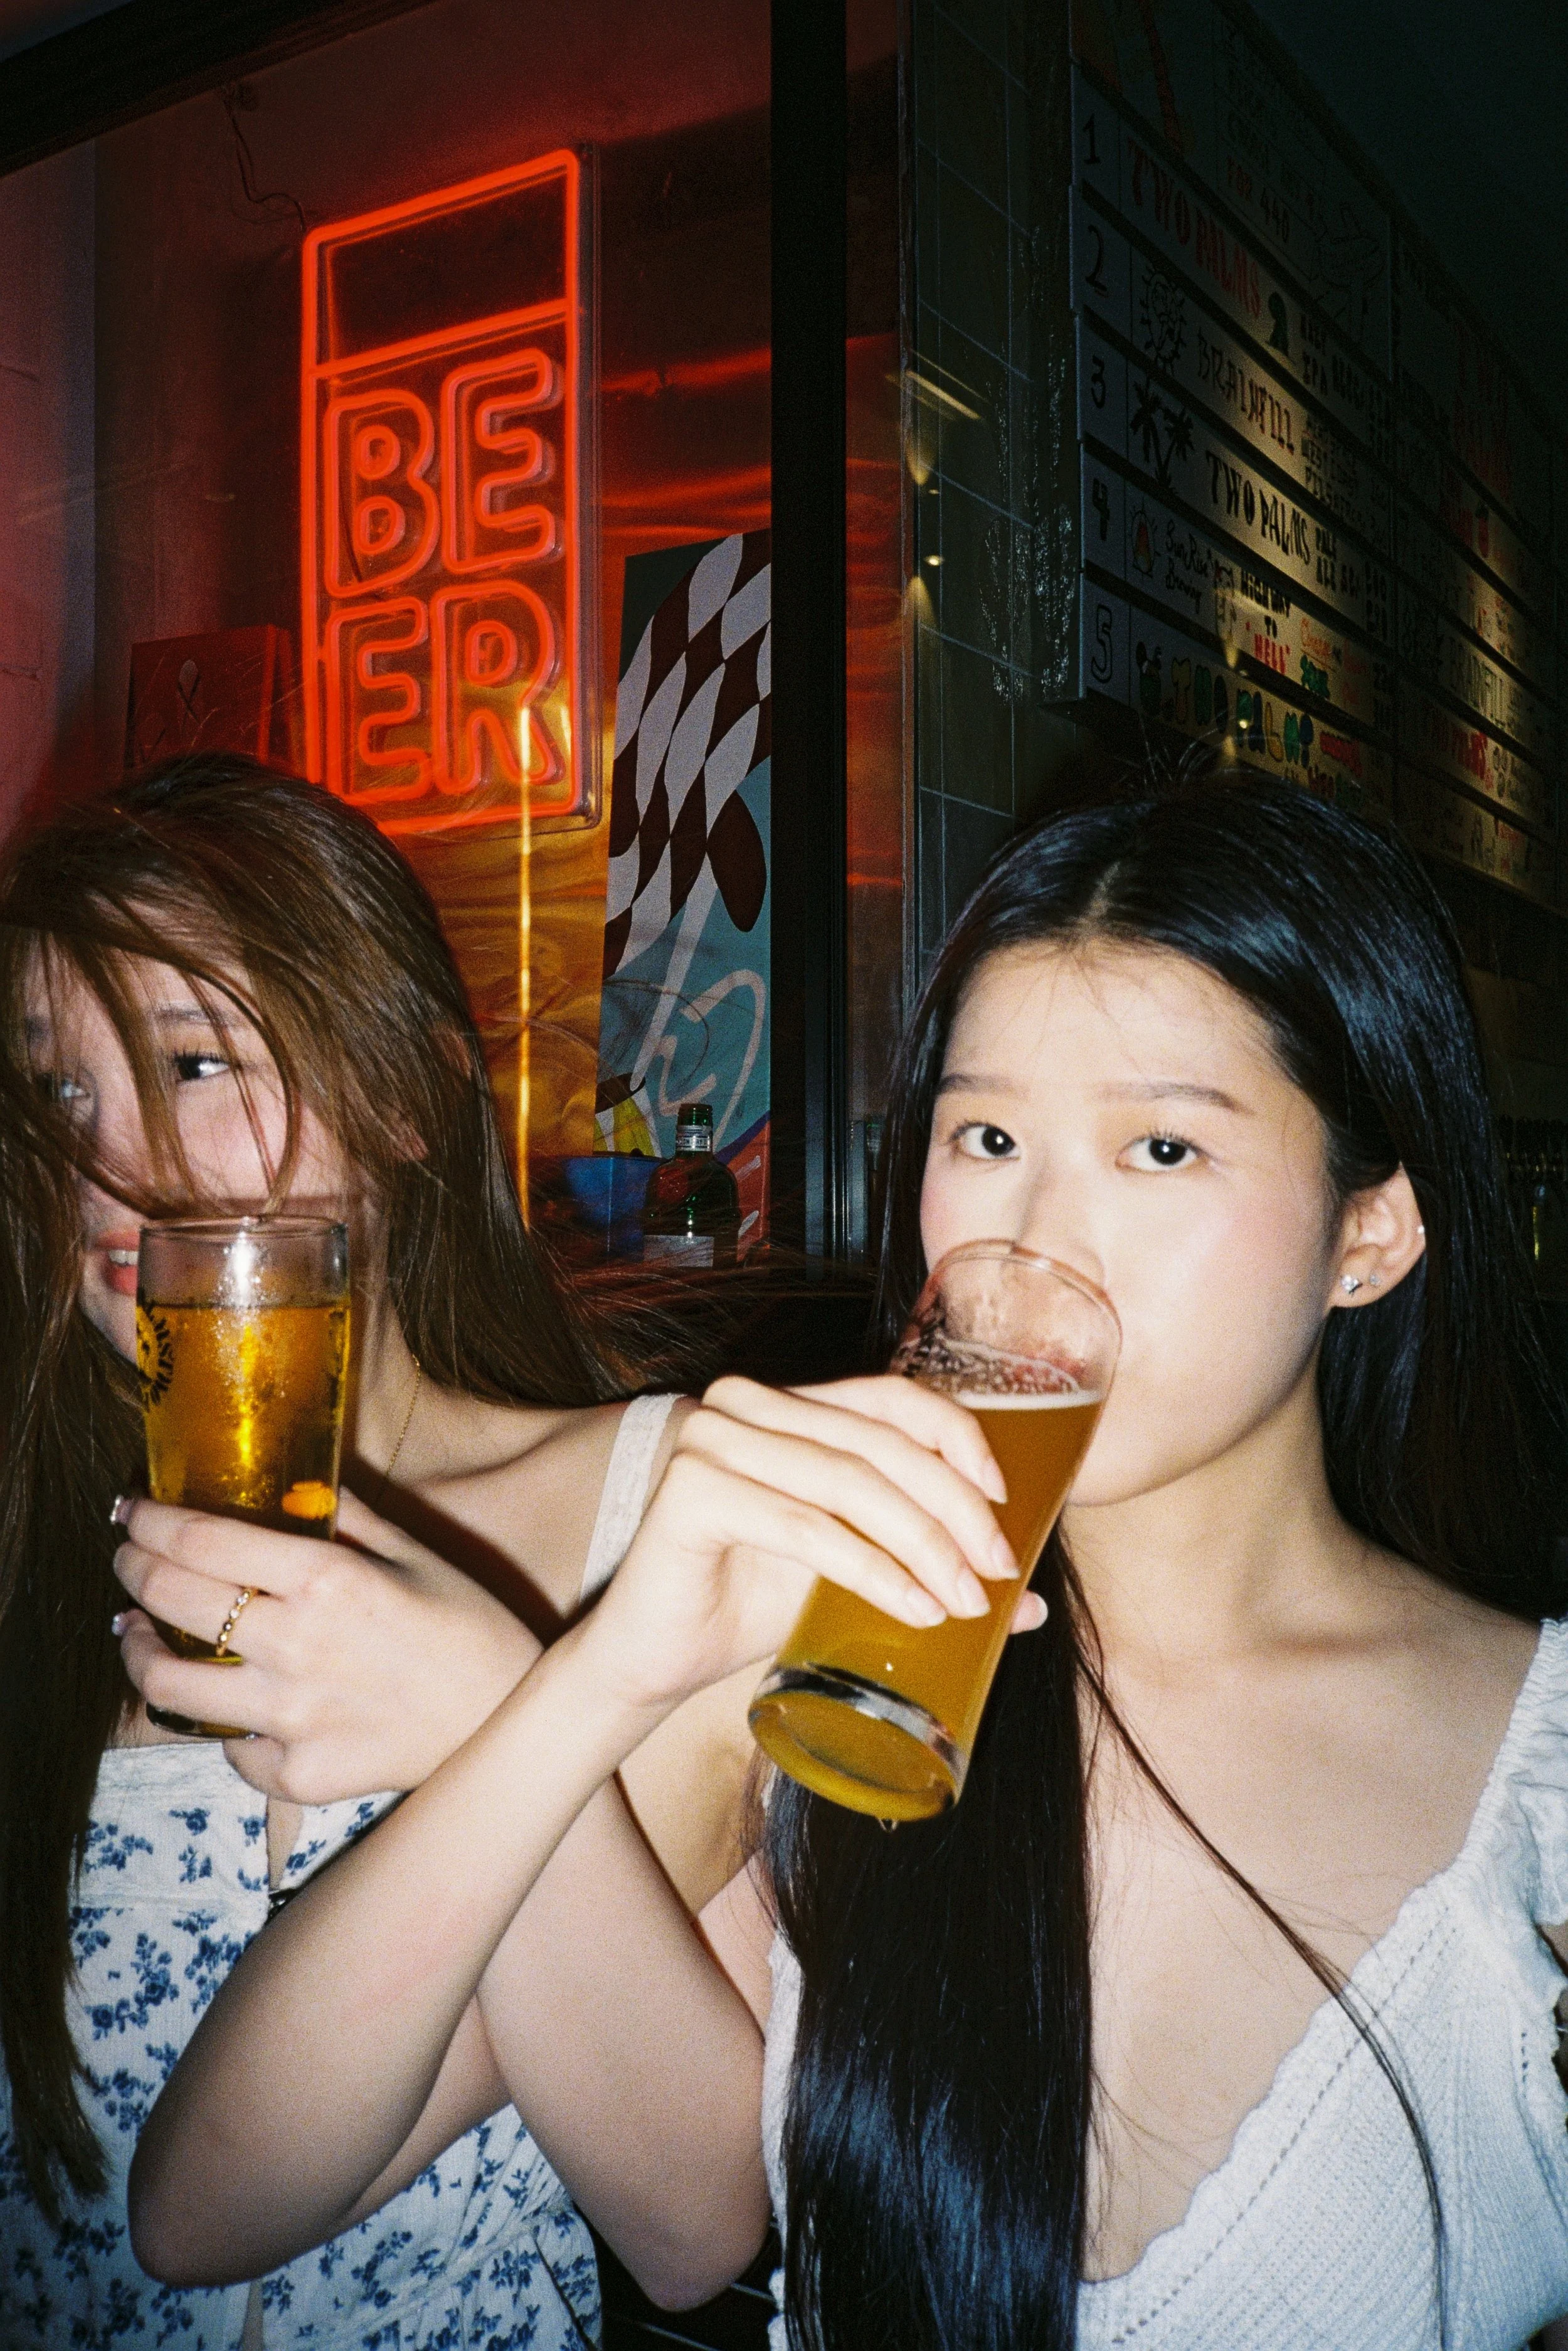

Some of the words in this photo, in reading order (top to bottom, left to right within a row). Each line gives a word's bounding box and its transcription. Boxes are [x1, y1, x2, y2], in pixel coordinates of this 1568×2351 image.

[1083, 113, 1099, 164] 1
[1086, 224, 1108, 294] 2
[1128, 136, 1190, 247] TWO
[1195, 207, 1261, 317] PALMS
[1091, 356, 1106, 409] 3
[1093, 479, 1110, 541] 4
[1206, 450, 1255, 525] TWO
[1259, 491, 1311, 566] PALMS
[1091, 603, 1113, 684] 5
